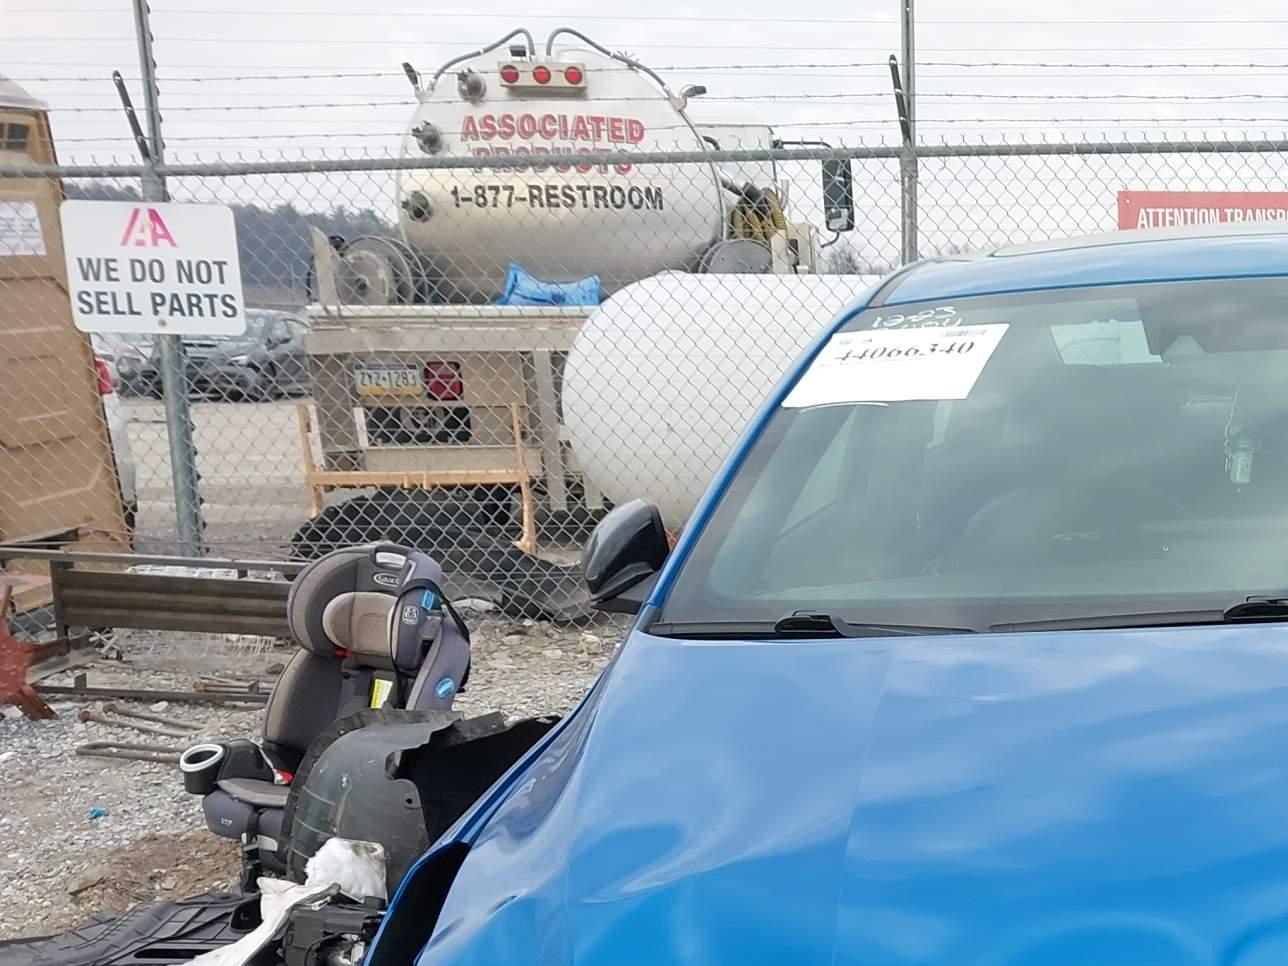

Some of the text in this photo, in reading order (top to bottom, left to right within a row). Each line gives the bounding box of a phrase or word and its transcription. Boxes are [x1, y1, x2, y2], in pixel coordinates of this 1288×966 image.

[461, 113, 645, 144] ASSOCIATED
[450, 184, 664, 210] 1-877-RESTROOM
[1137, 208, 1220, 230] ATTENTION
[77, 256, 228, 285] WE DO NOT
[77, 290, 238, 318] SELL PARTS
